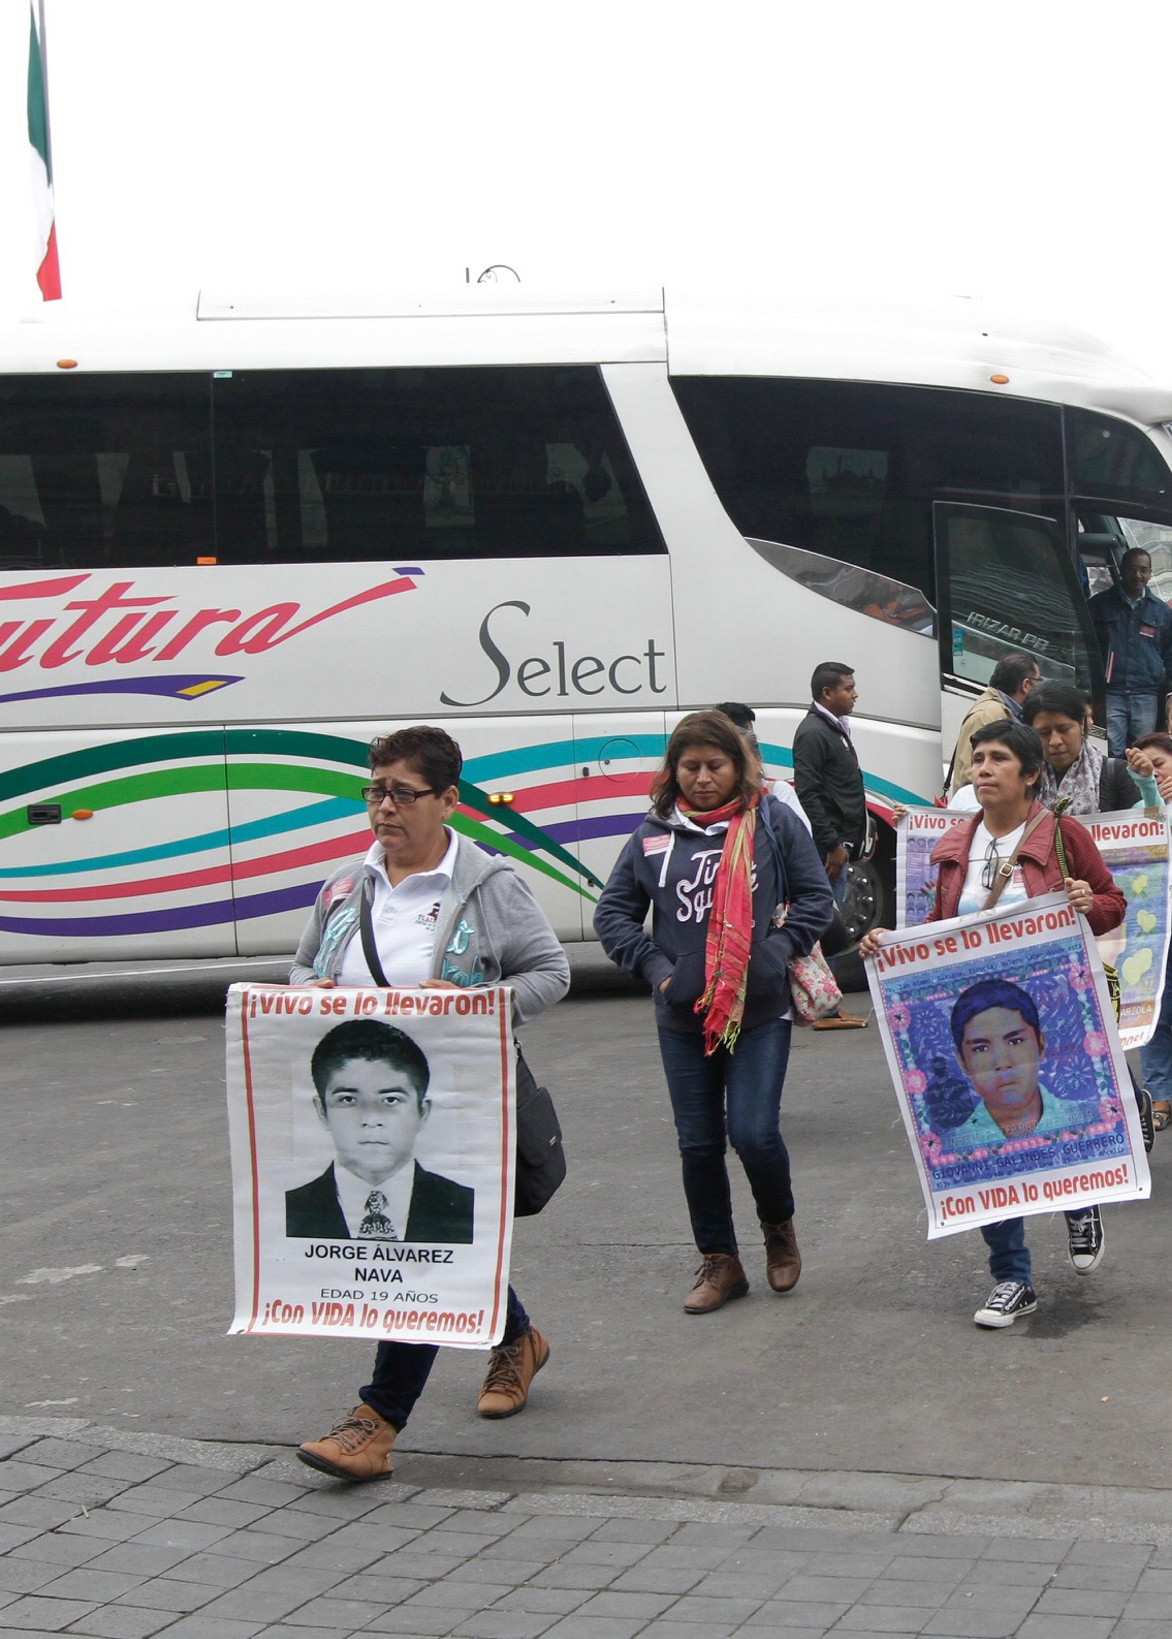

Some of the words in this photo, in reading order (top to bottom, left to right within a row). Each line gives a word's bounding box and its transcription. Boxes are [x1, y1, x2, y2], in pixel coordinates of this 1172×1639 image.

[966, 612, 1022, 641] IRIZAR
[440, 600, 667, 707] Select
[909, 814, 946, 830] ¡Vivo
[876, 943, 930, 972] ¡Vivo
[934, 936, 958, 956] se
[960, 930, 982, 949] lo
[986, 905, 1077, 942] llevaron!
[250, 992, 313, 1018] ¡Vivo
[320, 995, 347, 1015] se
[354, 992, 378, 1015] lo
[384, 990, 495, 1016] llevaron!
[932, 1160, 990, 1180] GIOVANNI
[996, 1148, 1056, 1168] GALINDES
[1063, 1134, 1124, 1155] GUERRERO
[941, 1195, 976, 1220] ¡Con
[978, 1186, 1020, 1210] VIDA
[1024, 1182, 1039, 1202] lo
[1044, 1164, 1129, 1200] queremos!
[305, 1244, 367, 1260] JORGE
[373, 1244, 454, 1264] ÁLVAREZ
[355, 1268, 403, 1284] NAVA
[320, 1288, 364, 1300] EDAD
[370, 1291, 388, 1302] 19
[395, 1290, 438, 1304] AÑOS
[262, 1299, 304, 1326] ¡Con
[311, 1302, 355, 1328] VIDA
[359, 1304, 378, 1328] lo
[384, 1309, 485, 1335] queremos!
